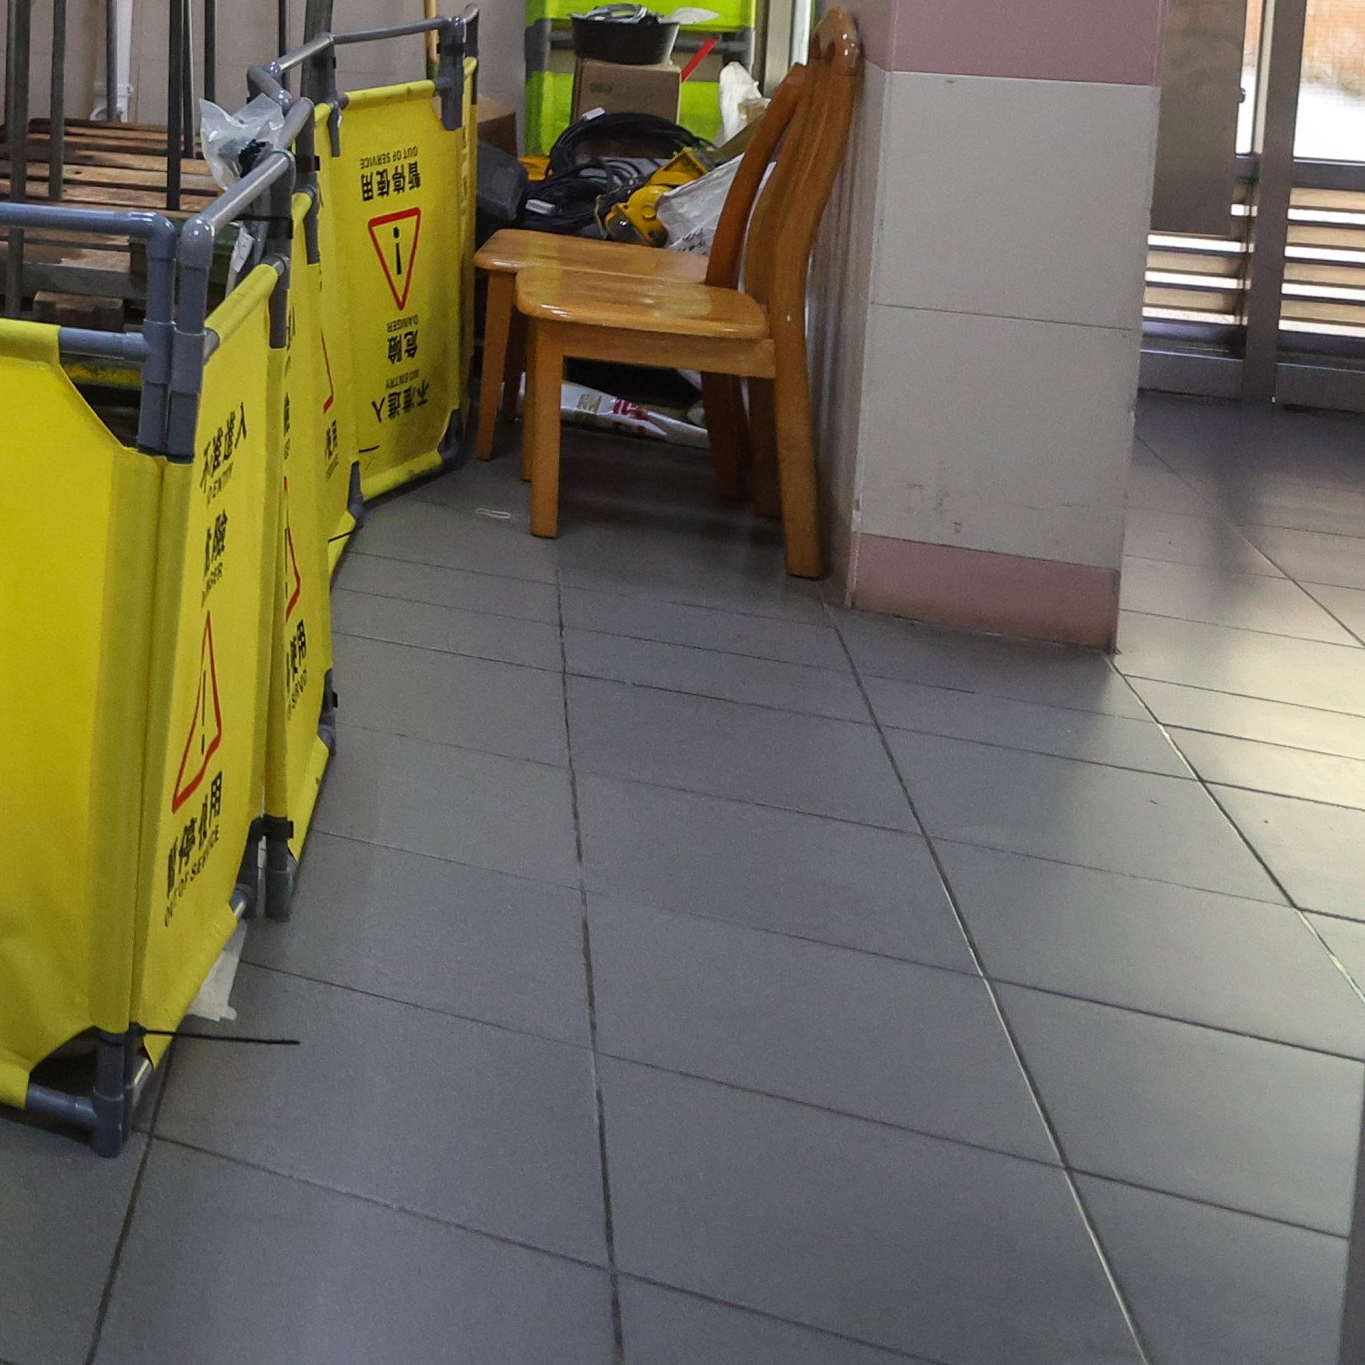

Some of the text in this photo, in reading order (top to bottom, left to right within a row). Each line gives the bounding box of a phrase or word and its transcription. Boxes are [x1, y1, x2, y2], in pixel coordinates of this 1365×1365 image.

[360, 145, 419, 170] OUT OF SERVICE
[360, 160, 421, 202] 暫停使用
[386, 313, 419, 333] DANGER
[387, 329, 419, 365] 危險
[371, 379, 430, 423] 不准進入
